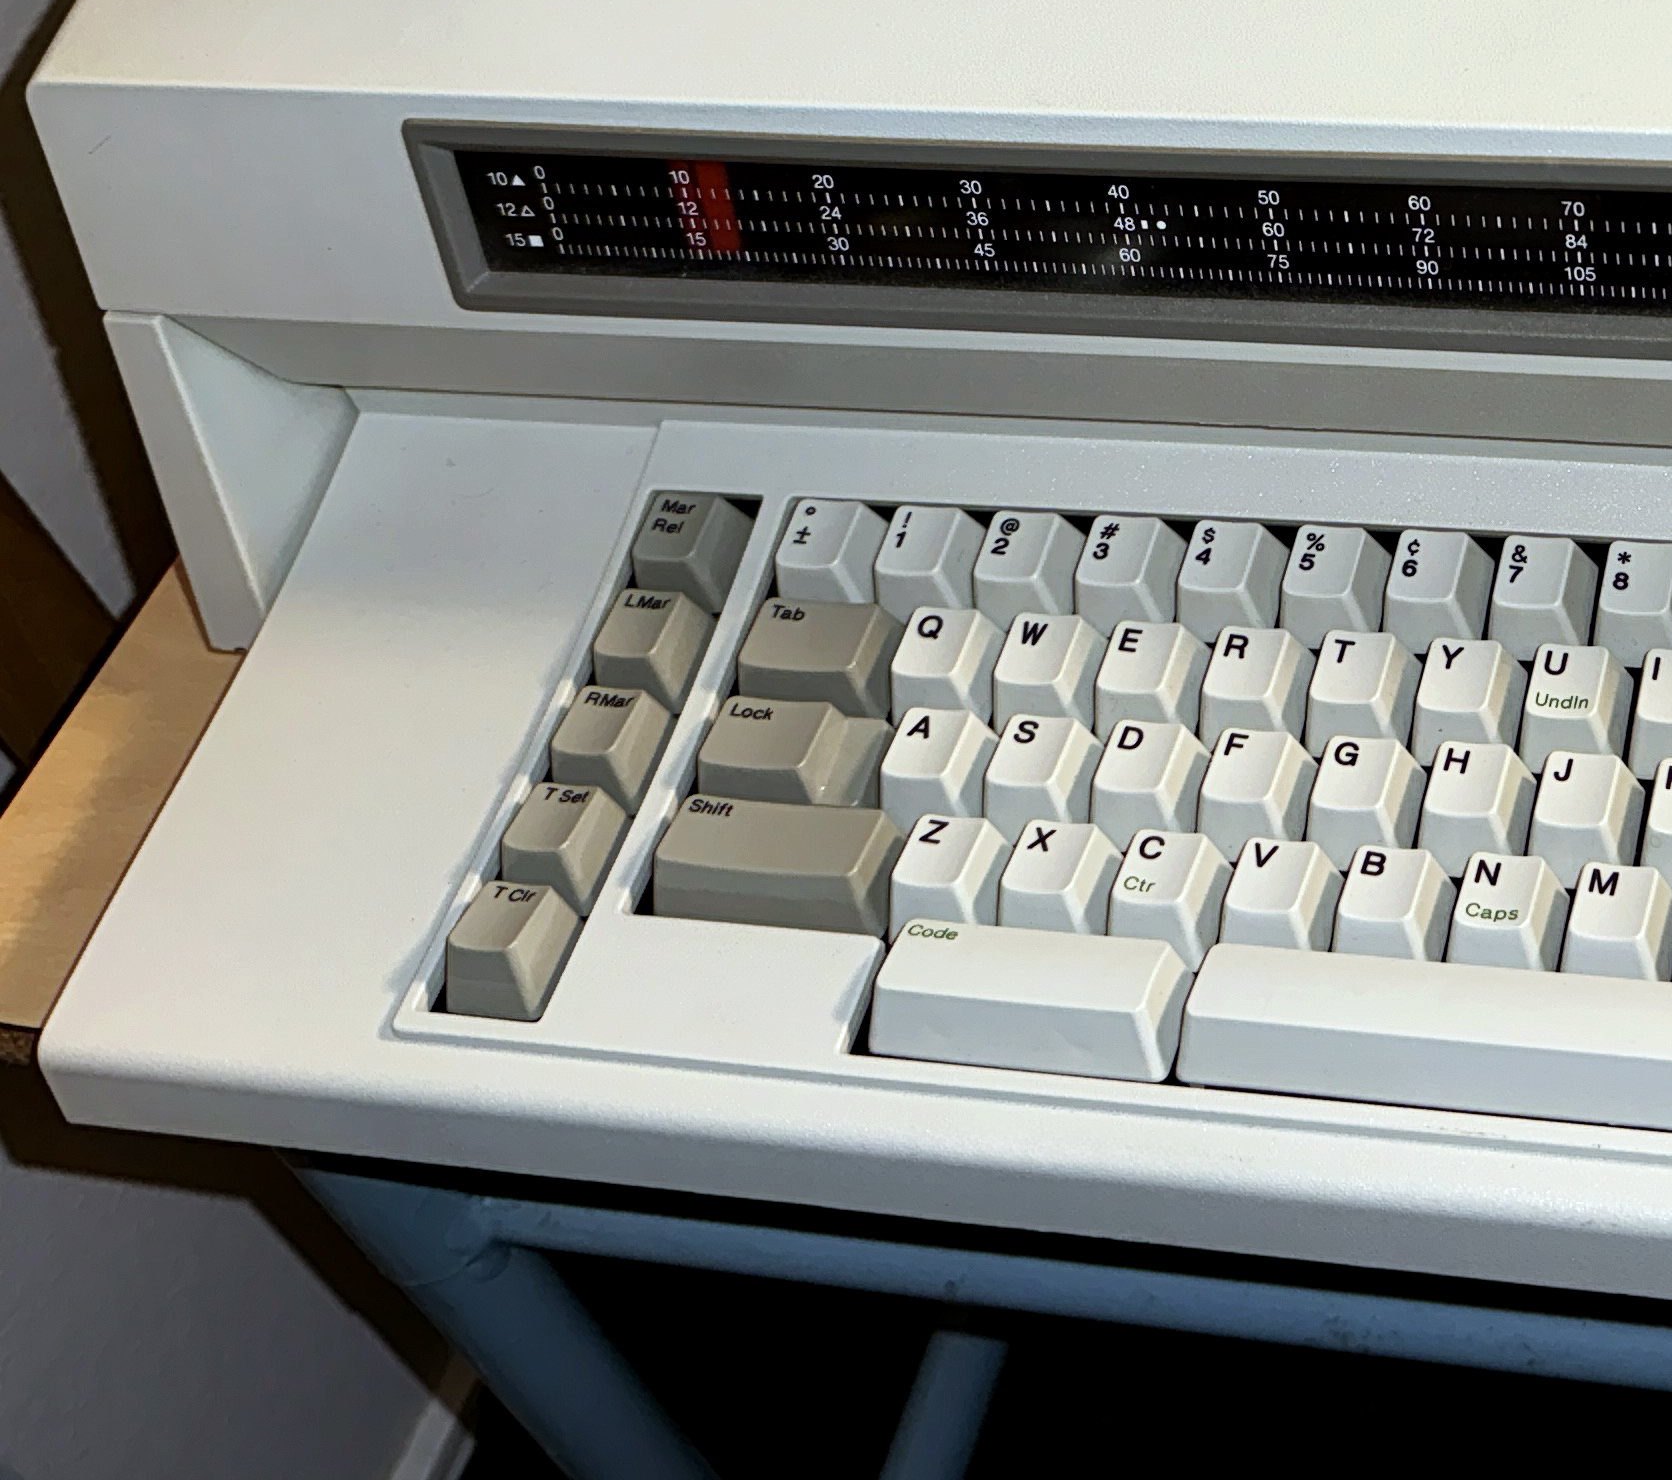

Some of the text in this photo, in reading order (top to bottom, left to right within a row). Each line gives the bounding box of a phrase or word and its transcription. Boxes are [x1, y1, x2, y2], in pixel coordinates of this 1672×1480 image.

[488, 172, 507, 185] 10
[534, 166, 545, 179] 0
[669, 171, 689, 184] 10
[812, 175, 834, 188] 20
[960, 180, 981, 194] 30
[1108, 185, 1129, 199] 40
[1258, 190, 1279, 205] 50
[1408, 196, 1430, 210] 60
[1562, 201, 1584, 216] 70
[497, 203, 517, 216] 12
[543, 197, 554, 210] 0
[678, 202, 698, 215] 12
[820, 206, 841, 219] 24
[967, 212, 988, 226] 36
[1114, 217, 1135, 231] 48
[1262, 222, 1284, 237] 60
[1412, 228, 1435, 243] 72
[1566, 234, 1587, 248] 84
[506, 233, 526, 246] 15
[552, 227, 563, 240] 0
[687, 232, 706, 246] 15
[828, 237, 849, 251] 30
[974, 243, 995, 257] 45
[1119, 248, 1140, 262] 60
[1268, 254, 1289, 269] 75
[1417, 260, 1438, 275] 90
[1565, 267, 1596, 281] 105
[661, 500, 696, 514] Mar
[652, 518, 684, 533] Rel
[902, 512, 912, 528] !
[1000, 518, 1020, 536] @
[1100, 523, 1119, 539] #
[896, 531, 906, 548] 1
[991, 538, 1009, 555] 2
[1202, 528, 1215, 544] $
[1307, 533, 1325, 551] %
[1093, 543, 1109, 560] 3
[1196, 548, 1211, 565] 4
[1299, 553, 1315, 570] 5
[1512, 545, 1527, 563] &
[1402, 560, 1418, 577] 6
[1509, 565, 1523, 583] 7
[1613, 572, 1629, 590] 8
[773, 604, 805, 621] Tab
[918, 615, 943, 639] Q
[1022, 621, 1048, 646] W
[1118, 628, 1143, 652] E
[1223, 634, 1248, 659] R
[1335, 639, 1355, 663] T
[1442, 645, 1464, 669] Y
[1545, 651, 1568, 675] U
[1652, 657, 1661, 680] I
[730, 703, 773, 720] Lock
[907, 716, 929, 739] A
[1014, 721, 1039, 743] S
[1117, 726, 1143, 750] D
[1224, 733, 1249, 755] F
[1334, 742, 1359, 766] G
[1444, 748, 1470, 774] H
[1554, 759, 1573, 781] J
[545, 787, 589, 803] T Set
[689, 799, 733, 816] Shift
[919, 820, 949, 844] Z
[1027, 827, 1056, 852] X
[1140, 836, 1165, 859] C
[1255, 843, 1279, 867] V
[1361, 851, 1386, 876] B
[1475, 860, 1501, 886] N
[495, 886, 508, 898] T
[1124, 876, 1156, 892] Ctr
[1589, 869, 1619, 896] M
[1466, 903, 1518, 922] Caps
[908, 924, 958, 940] Code
